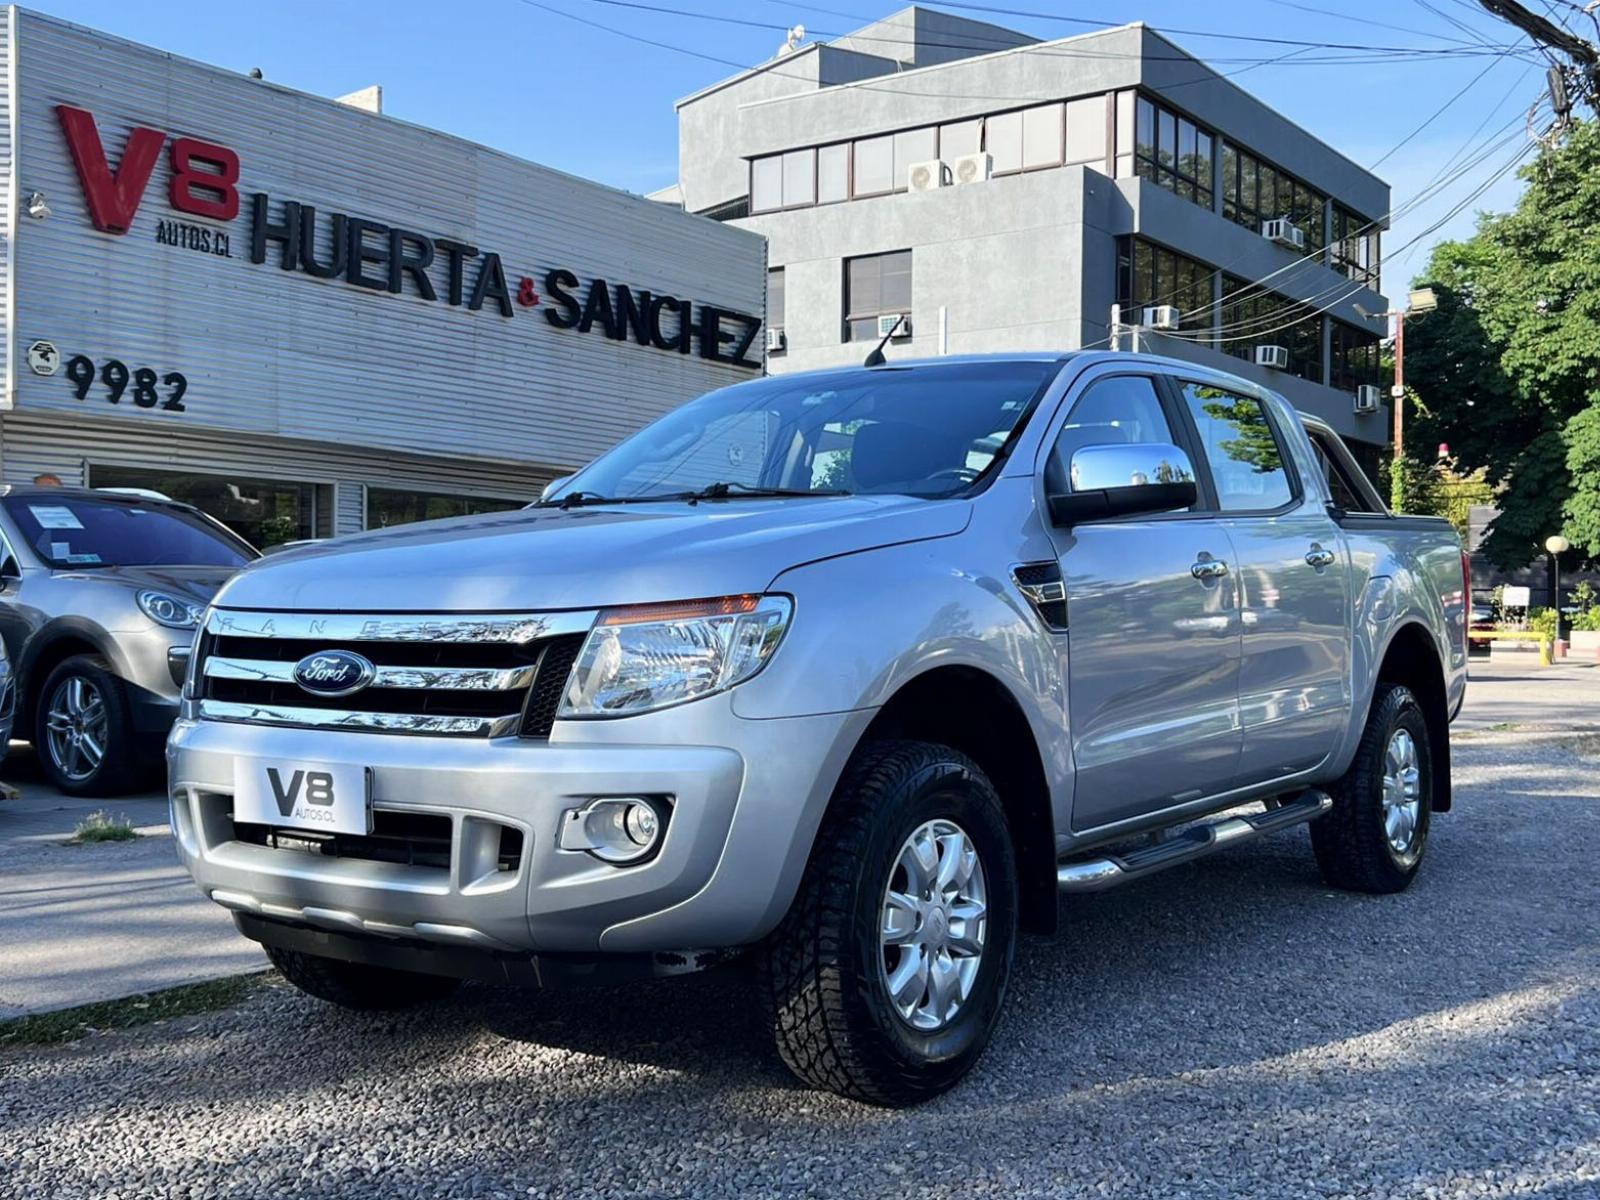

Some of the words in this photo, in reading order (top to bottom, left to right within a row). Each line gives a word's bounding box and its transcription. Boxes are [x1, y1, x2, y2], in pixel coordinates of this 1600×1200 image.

[56, 104, 240, 235] V8
[156, 220, 233, 258] AUTOS.CL
[250, 193, 514, 318] HUERTA
[517, 277, 540, 308] &
[545, 268, 762, 369] SANCHEZ
[67, 354, 188, 412] 9982
[304, 656, 349, 682] Ford
[266, 767, 335, 817] V8
